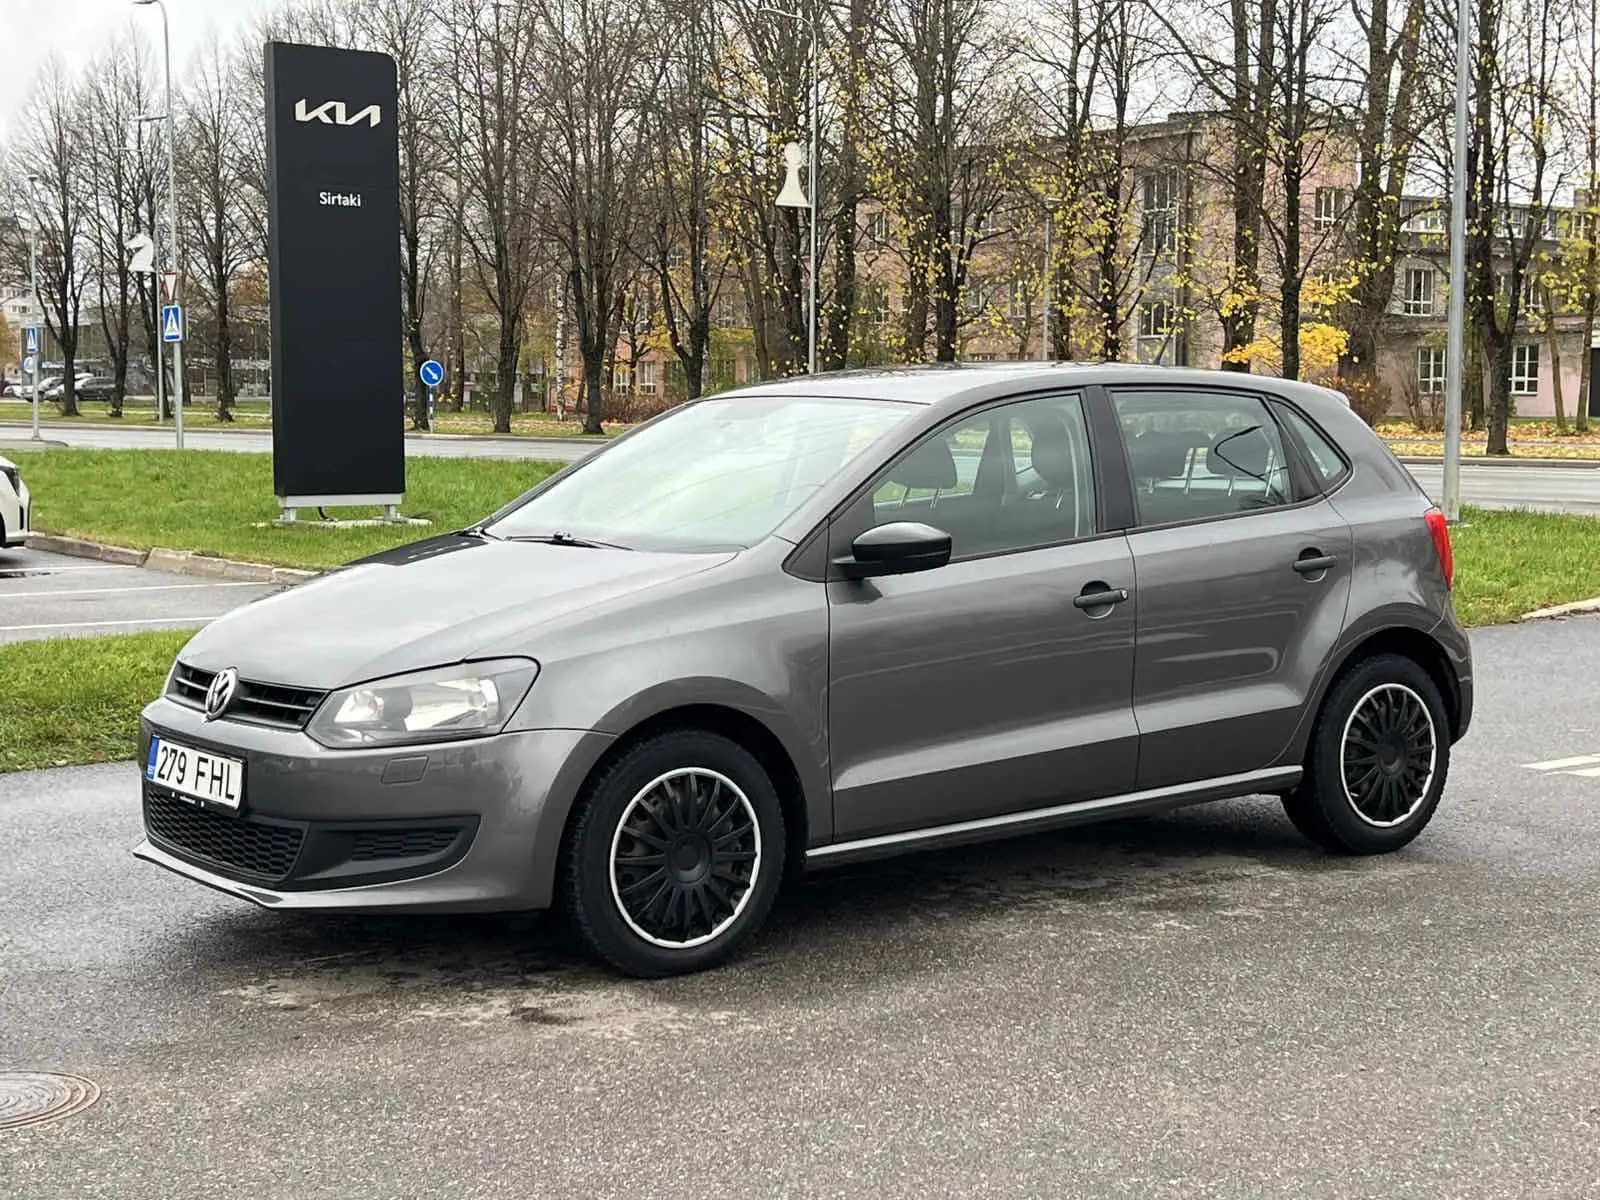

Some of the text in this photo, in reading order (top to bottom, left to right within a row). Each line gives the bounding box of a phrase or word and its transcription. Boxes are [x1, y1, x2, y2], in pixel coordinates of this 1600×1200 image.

[295, 98, 381, 128] KIA
[319, 191, 361, 207] Sirtaki
[157, 746, 235, 800] 279 FHL
